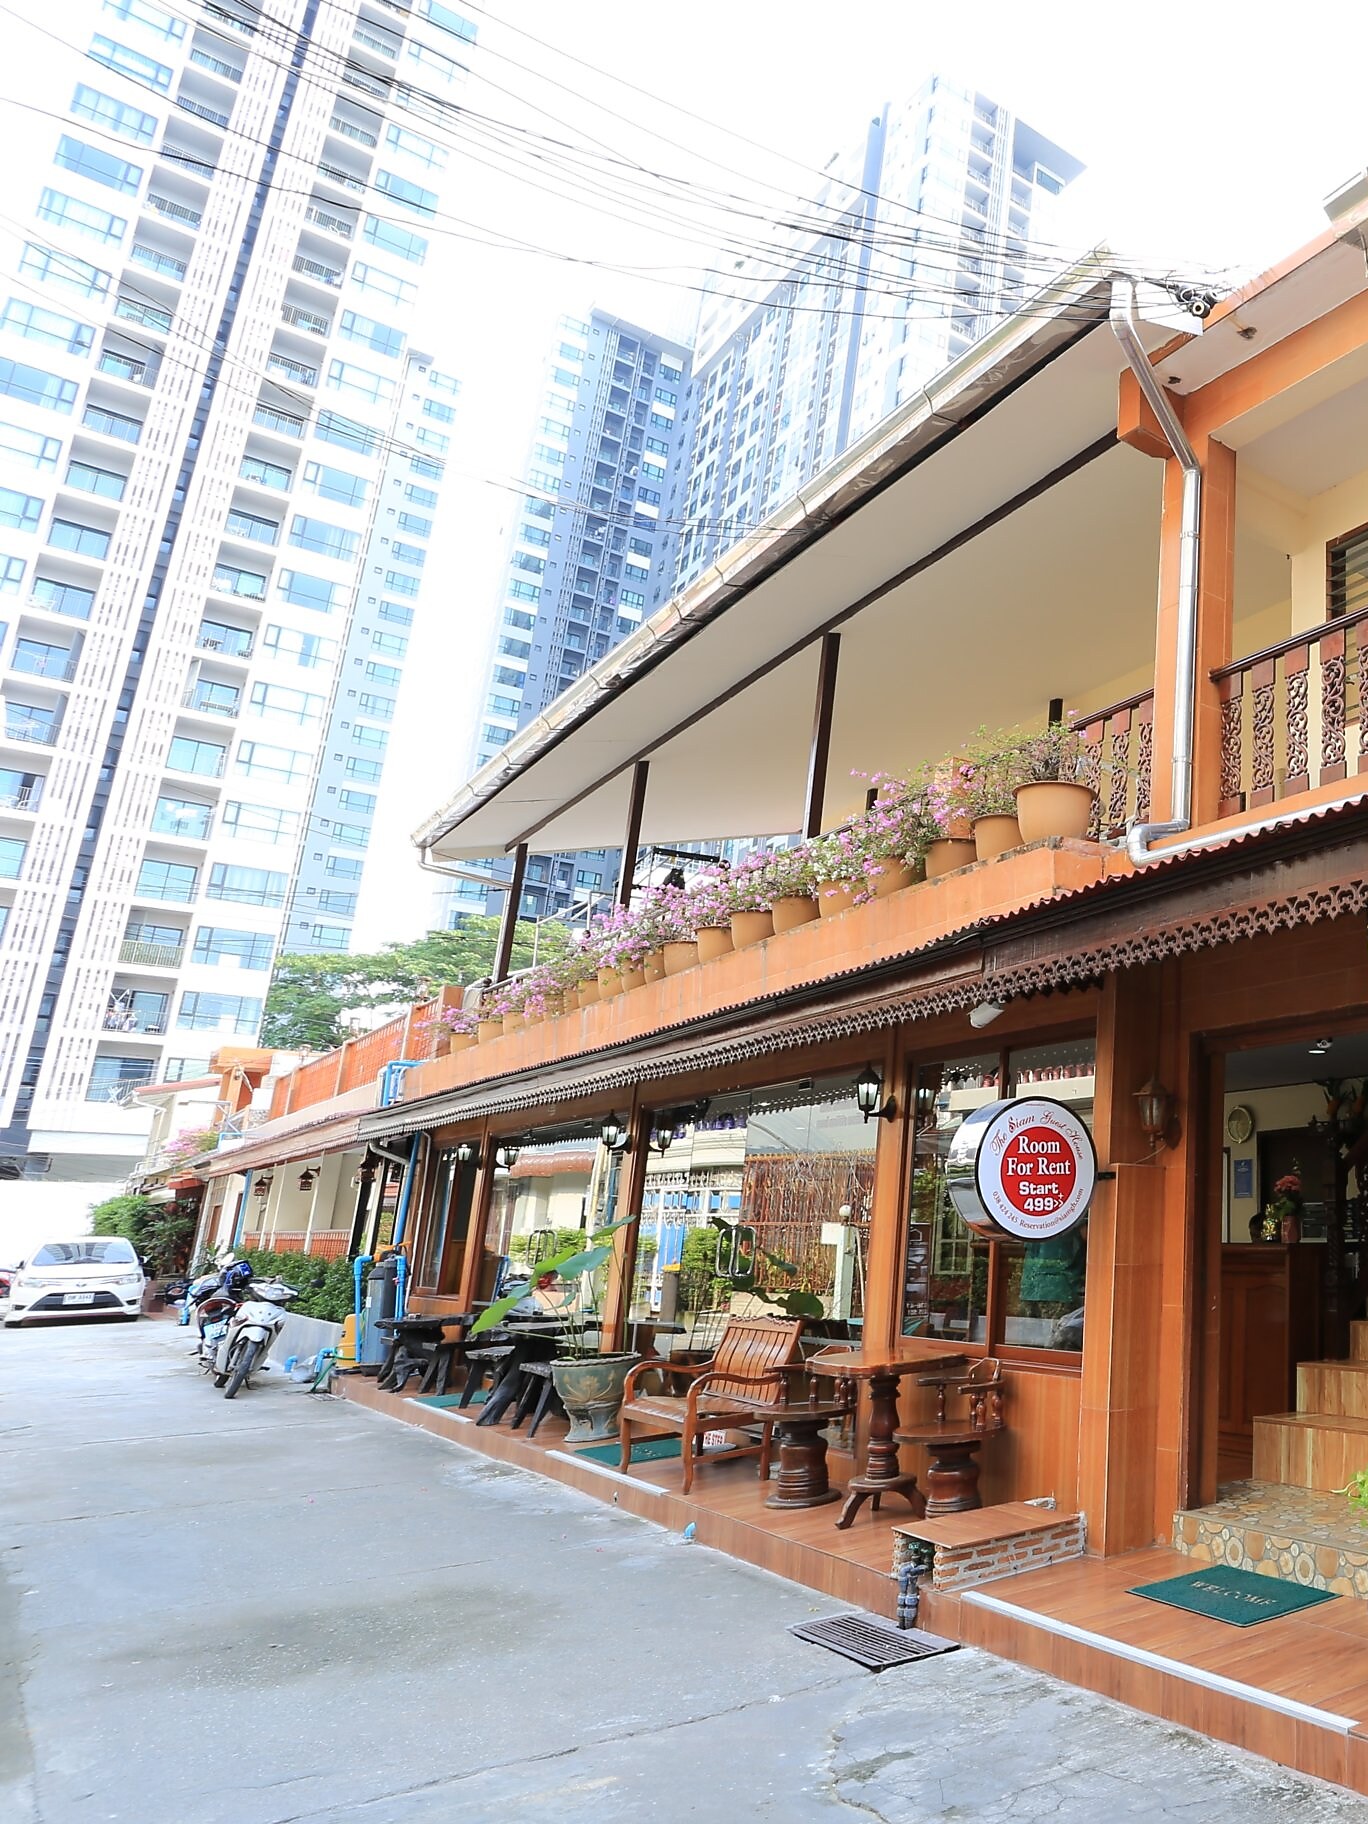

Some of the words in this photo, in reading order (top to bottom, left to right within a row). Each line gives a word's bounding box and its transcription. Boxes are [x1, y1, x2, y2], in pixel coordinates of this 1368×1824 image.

[990, 1128, 1008, 1156] The
[1008, 1115, 1035, 1134] Siam
[1041, 1110, 1067, 1129] Guest
[1065, 1127, 1084, 1160] House
[1017, 1135, 1060, 1154] Room
[1006, 1157, 1034, 1176] For
[1036, 1157, 1071, 1175] Rent
[1019, 1181, 1059, 1195] Start
